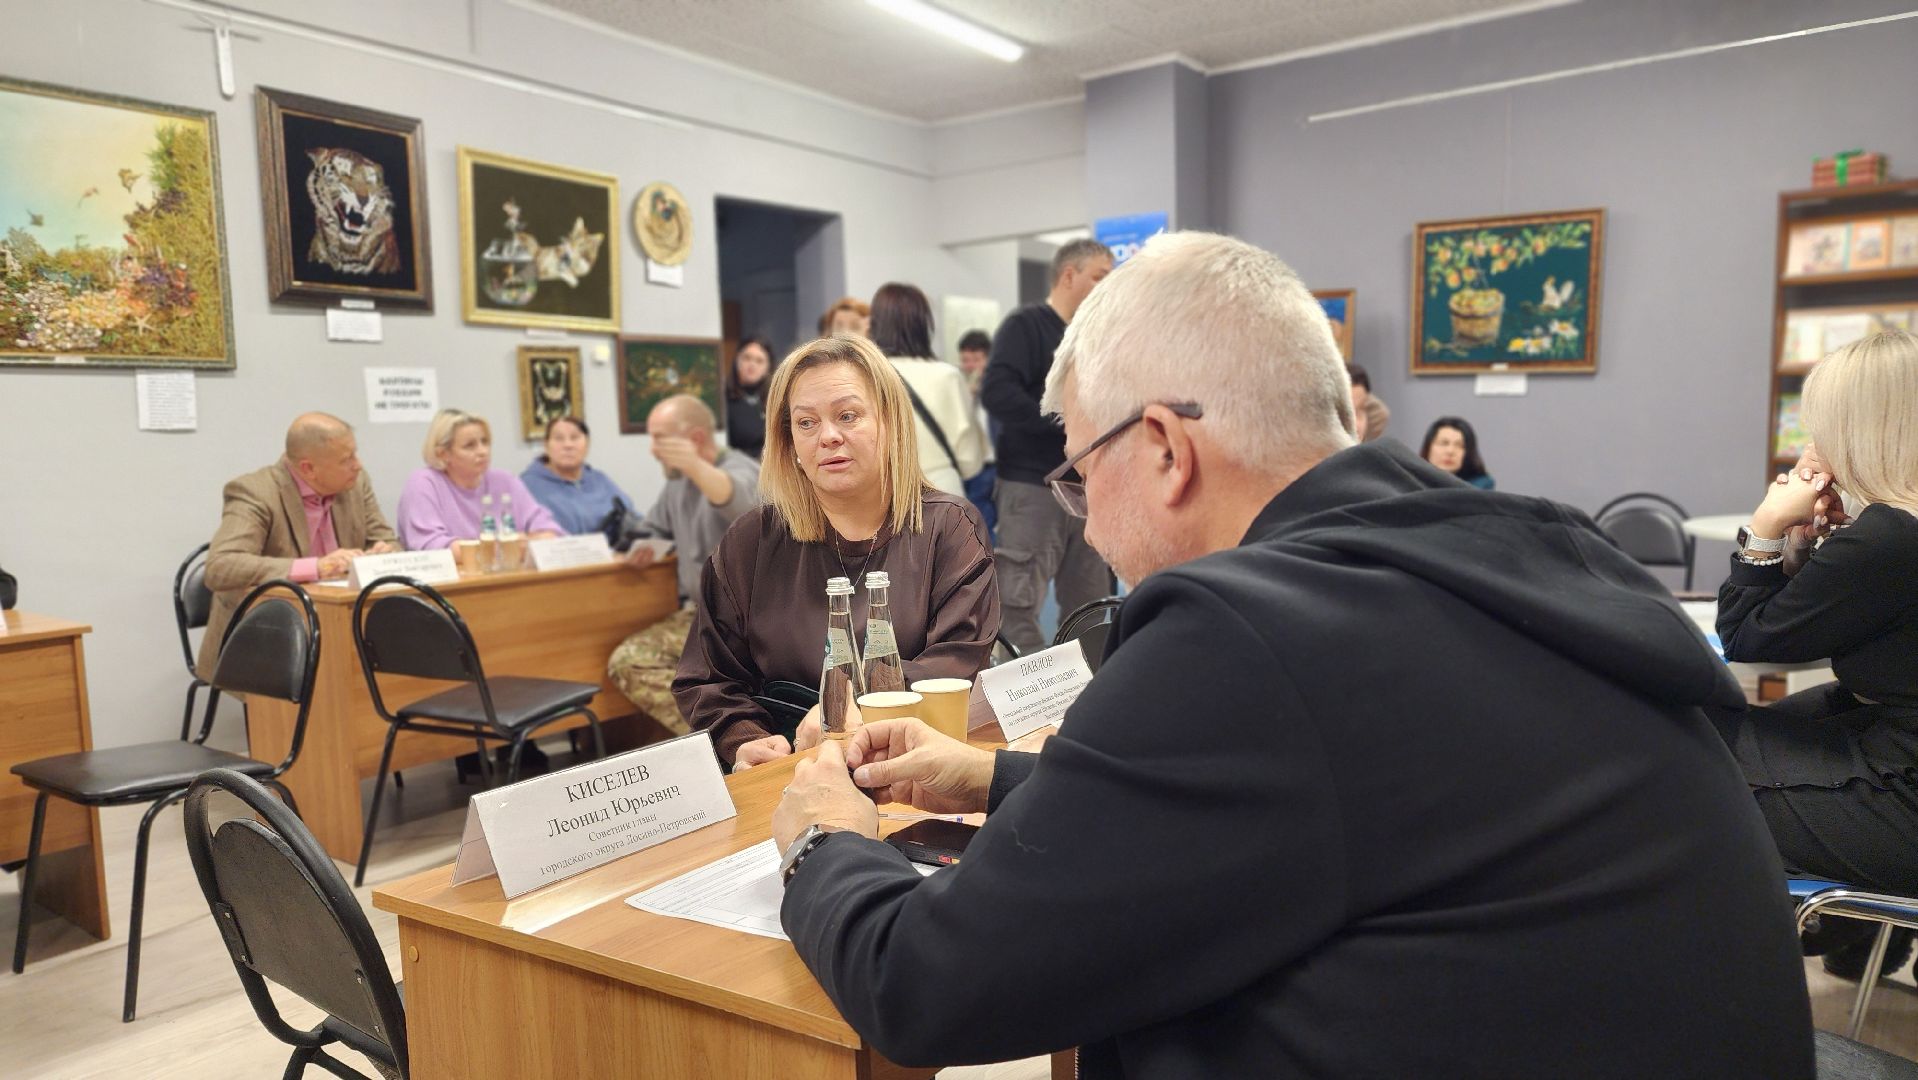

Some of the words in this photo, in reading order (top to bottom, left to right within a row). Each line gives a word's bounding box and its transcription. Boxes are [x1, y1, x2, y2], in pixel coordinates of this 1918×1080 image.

[1005, 680, 1040, 702] Николай
[1037, 668, 1079, 690] Николаевич
[565, 764, 650, 803] КИСЕЛЕВ
[547, 807, 611, 838] Леонид
[610, 785, 681, 815] Юрьевич
[588, 821, 631, 842] Советник
[632, 813, 657, 828] главы
[595, 840, 625, 854] округа
[627, 809, 707, 845] Лосино-Петровский
